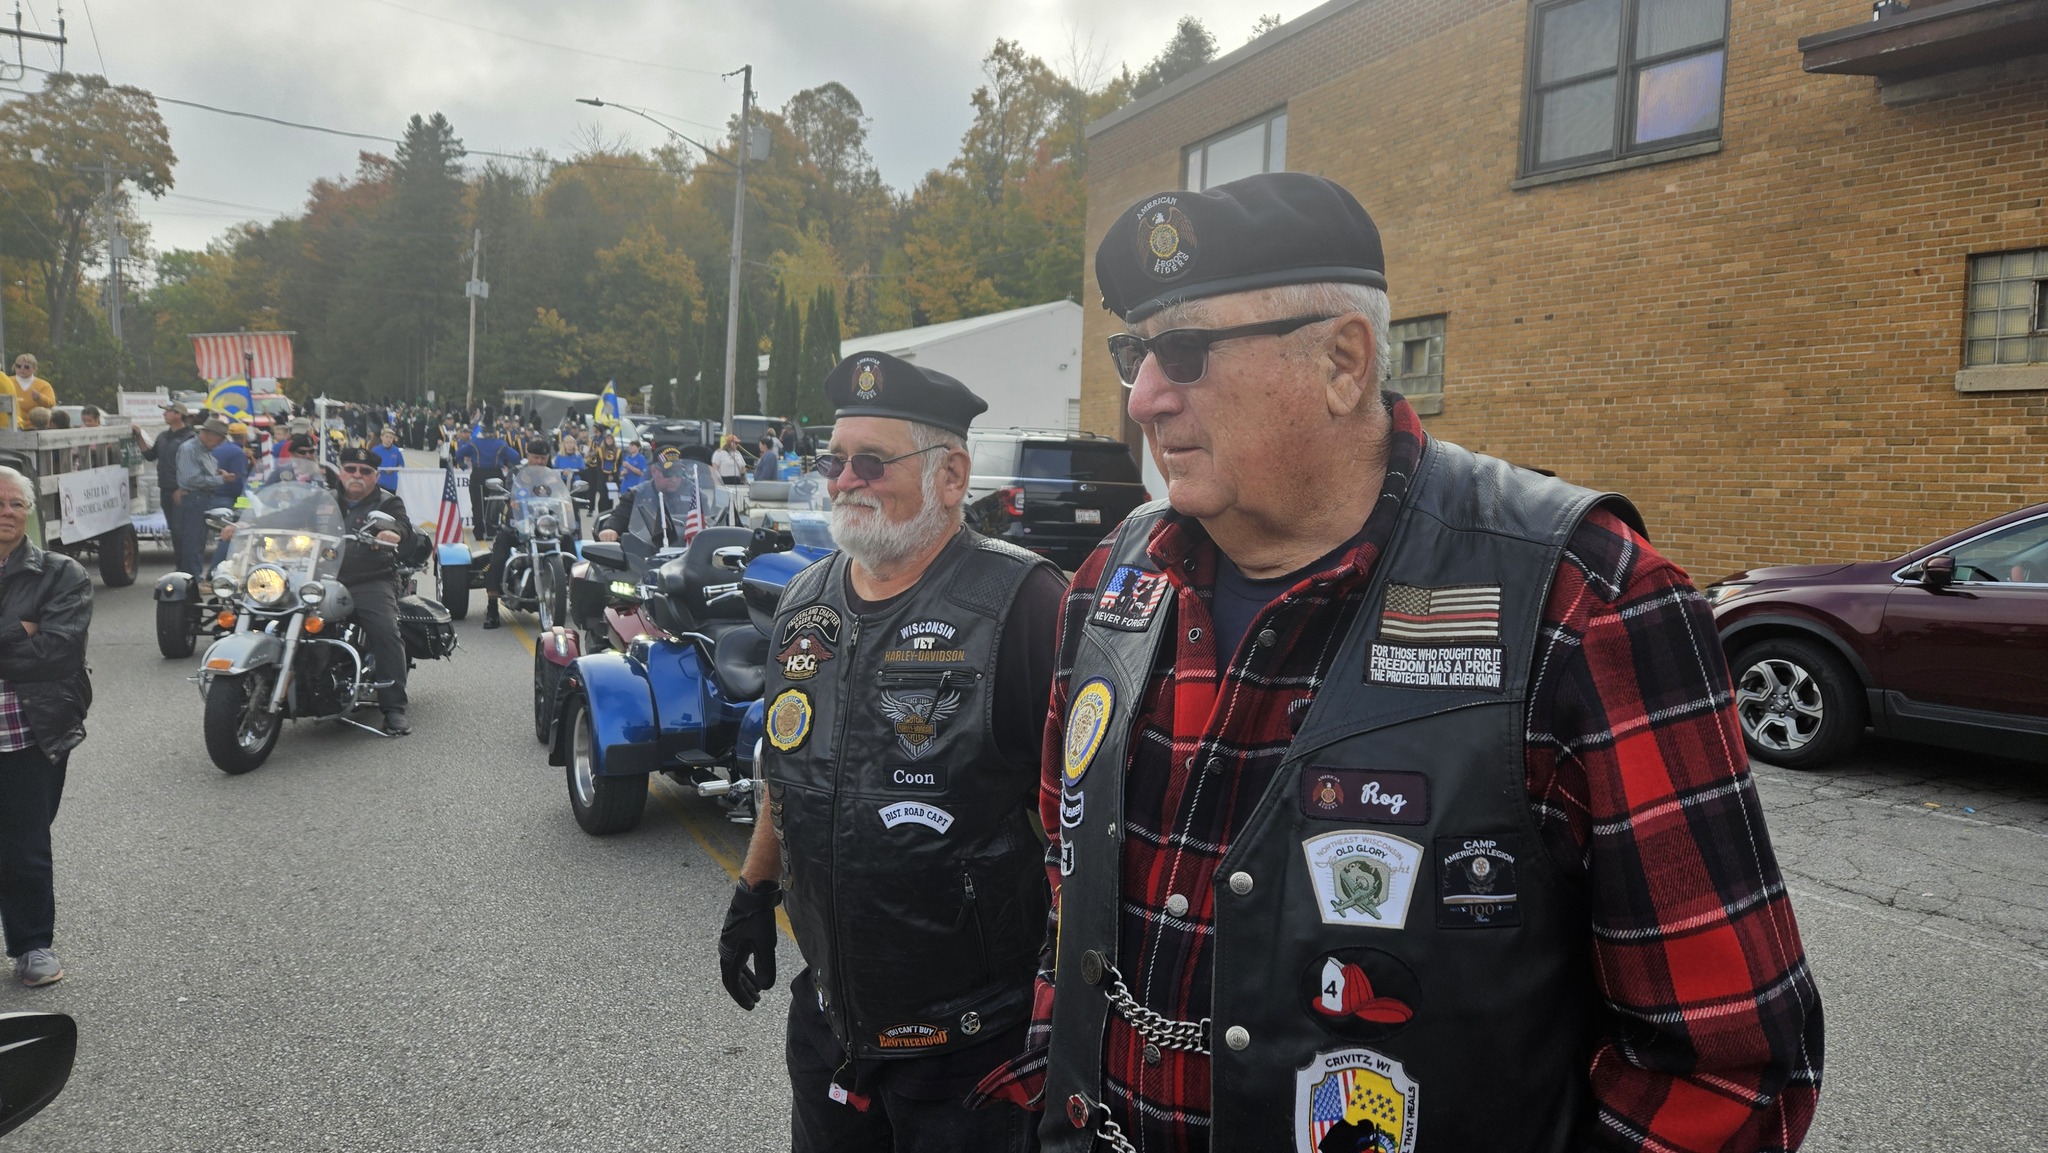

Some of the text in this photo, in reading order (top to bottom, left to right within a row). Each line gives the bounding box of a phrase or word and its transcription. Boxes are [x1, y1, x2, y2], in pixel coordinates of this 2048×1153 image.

[1137, 196, 1177, 220] AMERICAN
[1154, 253, 1189, 274] RIDERS
[1157, 250, 1183, 268] LEGION
[795, 615, 811, 629] GREEN
[812, 614, 823, 623] BAY
[819, 608, 840, 627] CHAPTER
[1094, 611, 1150, 628] NEVER FORGET
[900, 621, 956, 640] WISCONSIN
[913, 637, 936, 650] VET
[1371, 644, 1502, 661] FOR THOSE WHO FOUGHT FOR IT
[786, 654, 816, 671] HOG
[885, 650, 966, 662] HARLEY-DAVIDSON
[1371, 656, 1501, 675] FREEDOM HAS A PRICE
[1370, 668, 1500, 688] THE PROTECTED WILL NEVER KNOW
[893, 769, 935, 785] Coon
[1361, 781, 1407, 814] Rog
[904, 807, 925, 817] ROAD
[926, 811, 949, 827] CAPT
[1316, 836, 1404, 861] NORTHEAST WISCONSIN
[1335, 844, 1388, 859] OLD GLORY
[1463, 840, 1497, 850] CAMP
[1444, 848, 1515, 866] AMERICAN LEGION
[1469, 903, 1495, 916] 100
[1324, 980, 1338, 998] 4
[886, 1025, 934, 1038] YOU CAN'T BUY
[1325, 1053, 1391, 1073] CRIVITZ, WI
[1408, 1085, 1416, 1119] HEALS
[1404, 1120, 1415, 1147] THAT
